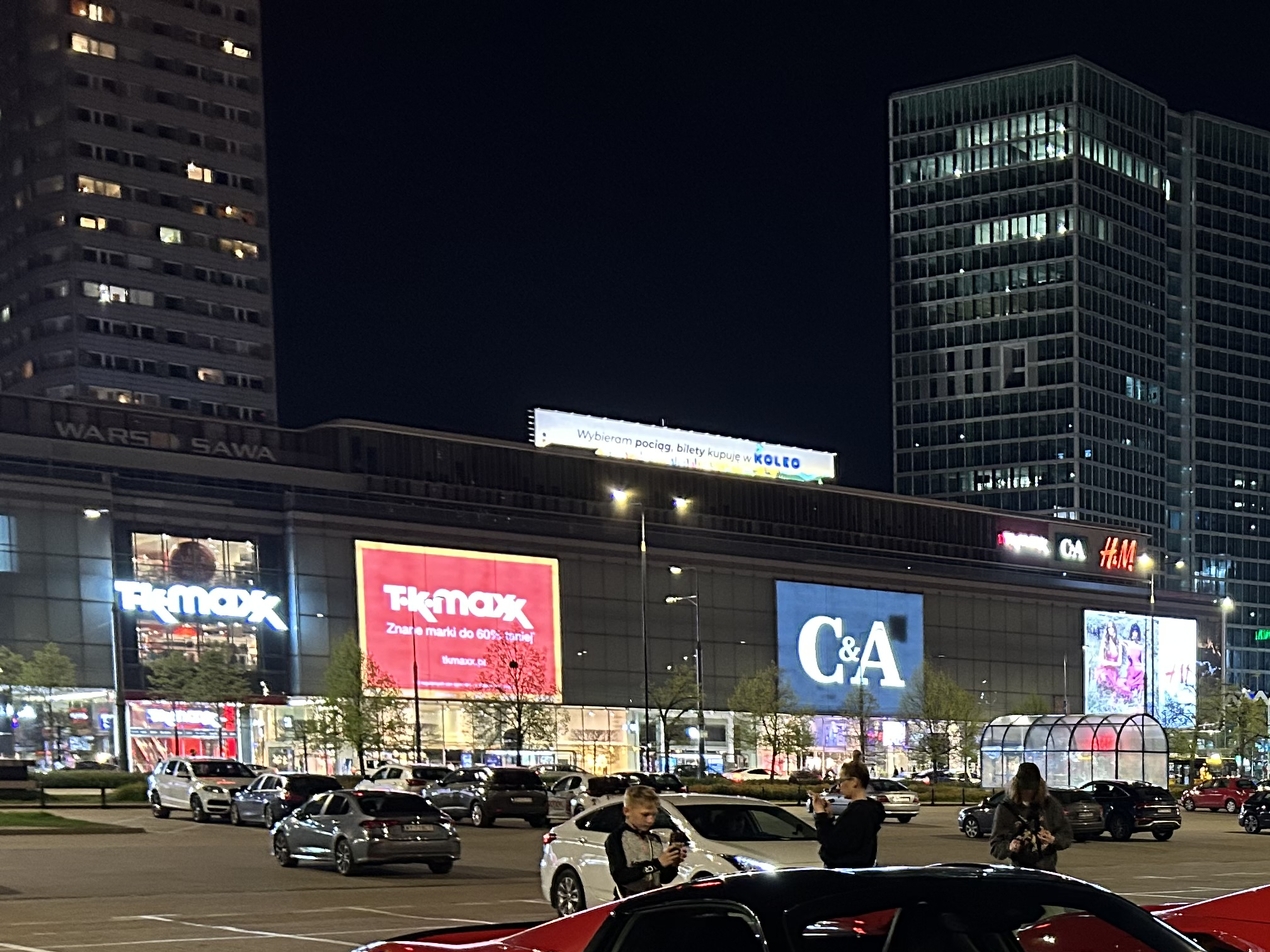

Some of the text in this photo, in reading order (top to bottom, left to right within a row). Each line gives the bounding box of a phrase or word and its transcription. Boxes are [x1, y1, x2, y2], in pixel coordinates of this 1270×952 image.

[55, 421, 277, 462] WARS SAWA
[577, 428, 632, 446] Wybieram
[676, 443, 705, 458] bilety
[707, 448, 740, 463] kupuję
[743, 455, 752, 463] w
[754, 452, 801, 470] KOLEO
[1100, 536, 1137, 572] H&M
[386, 622, 424, 636] Znane
[425, 625, 457, 638] marki
[459, 626, 474, 639] do
[798, 615, 906, 688] C&A
